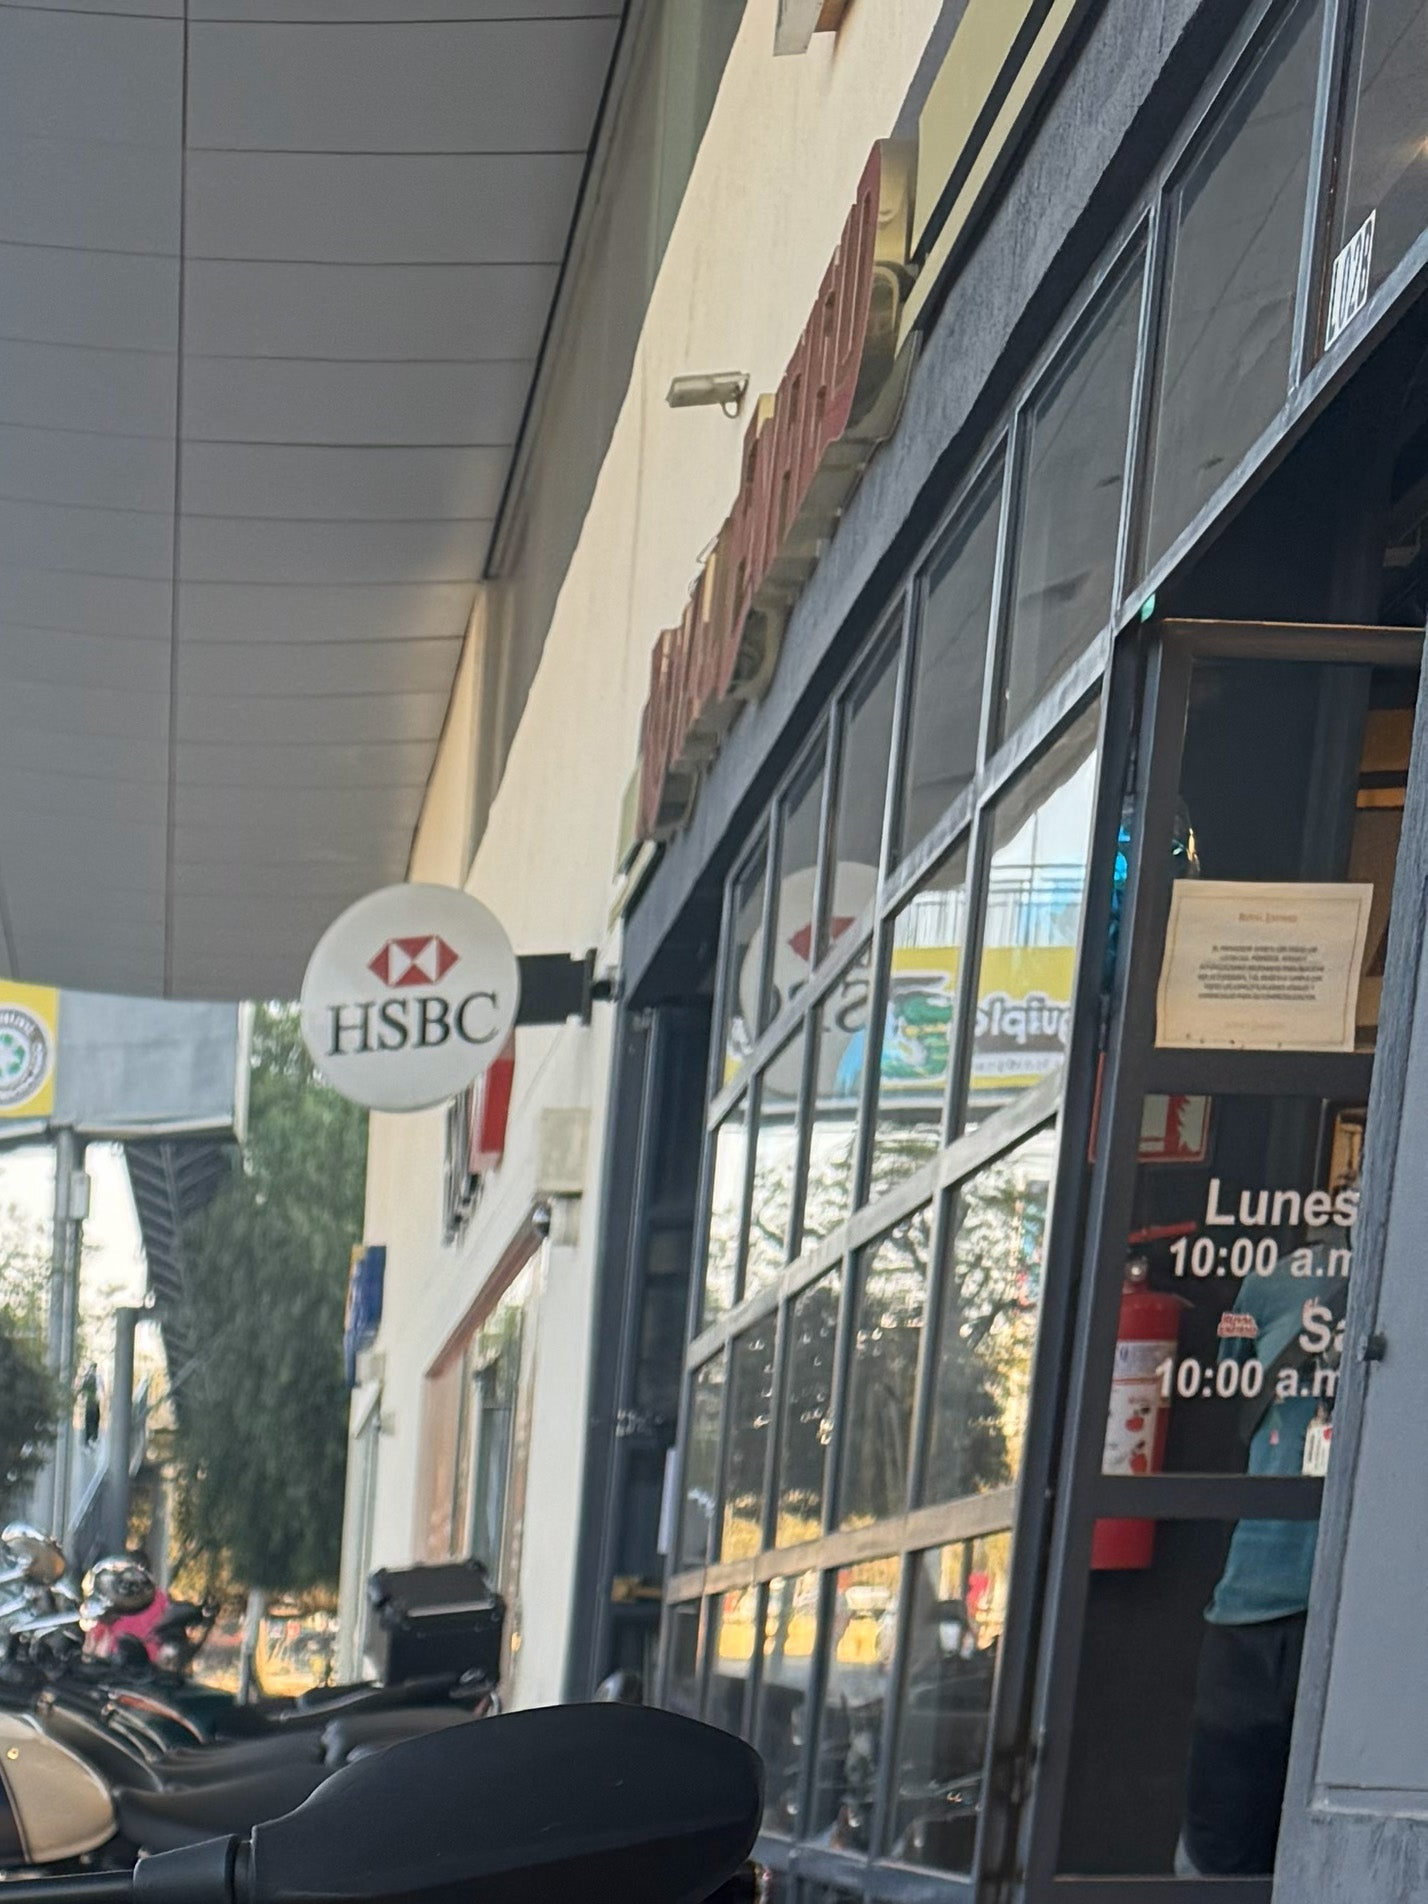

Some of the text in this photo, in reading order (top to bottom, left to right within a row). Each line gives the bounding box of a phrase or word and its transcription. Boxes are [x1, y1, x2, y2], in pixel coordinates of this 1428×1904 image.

[326, 991, 500, 1057] HSBC
[1205, 1177, 1359, 1226] Lunes
[1169, 1236, 1279, 1278] 10:00
[1155, 1357, 1264, 1398] 10:00
